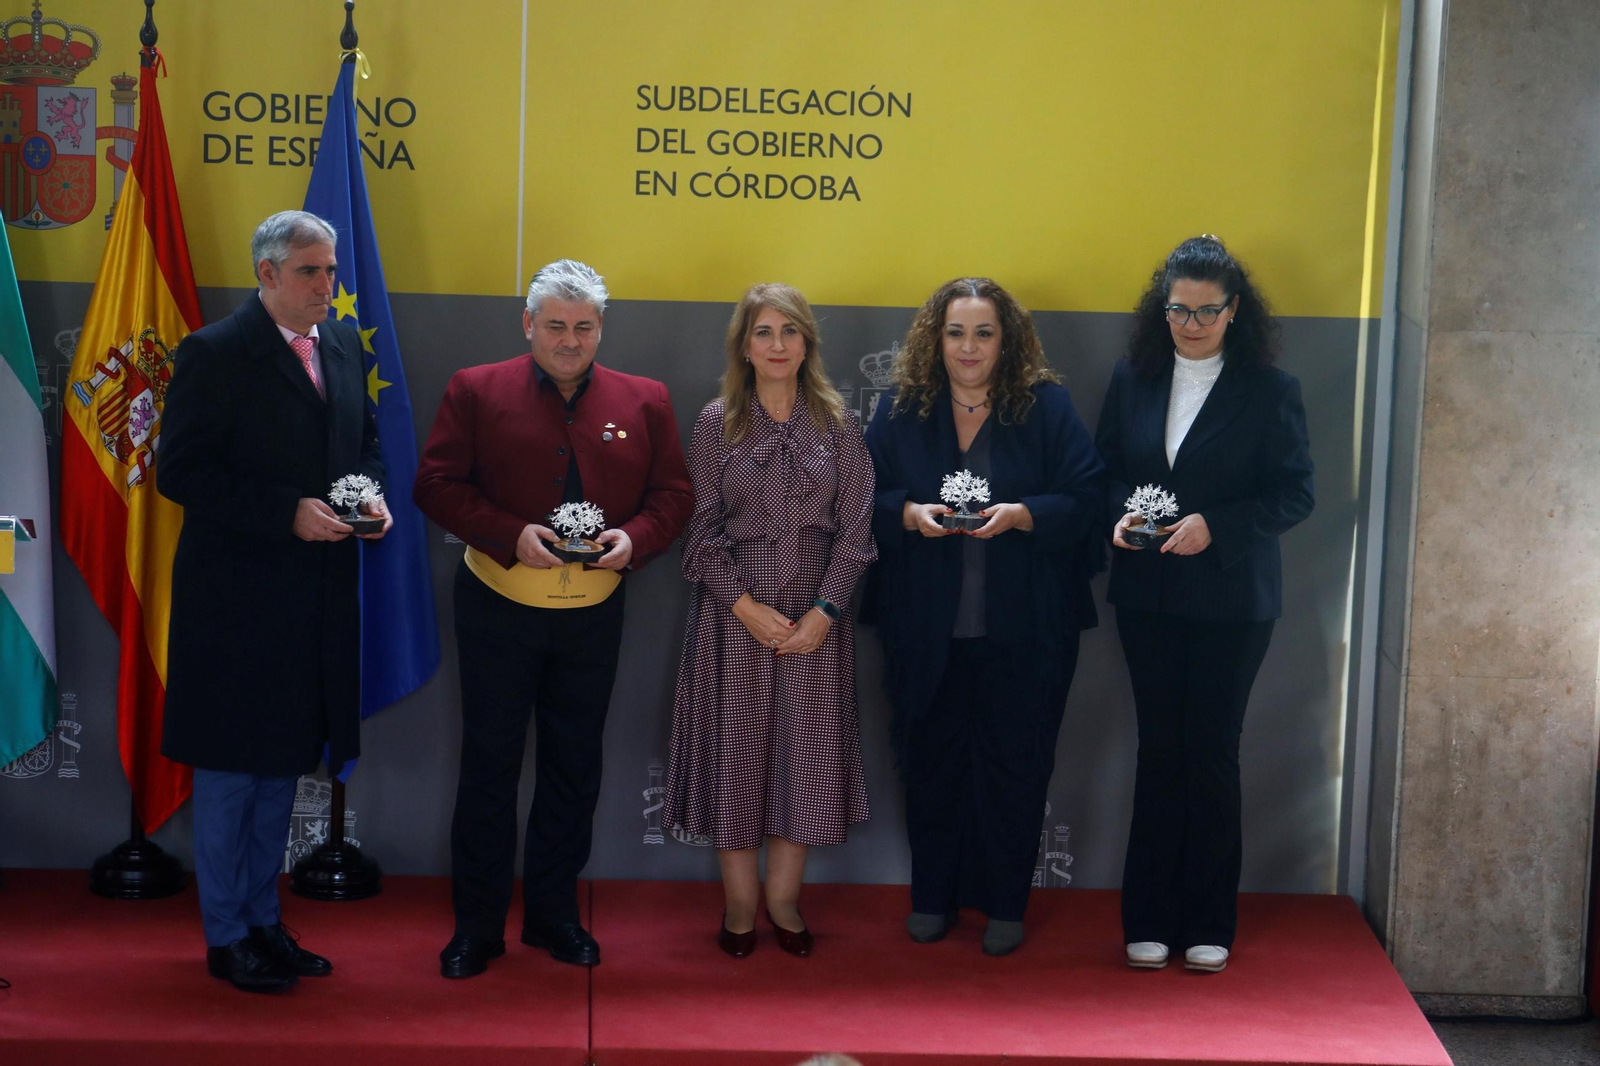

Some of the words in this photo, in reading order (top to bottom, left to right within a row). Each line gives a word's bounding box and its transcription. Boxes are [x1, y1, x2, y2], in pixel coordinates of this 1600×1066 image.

[202, 90, 417, 128] GOBIENO
[636, 84, 912, 118] SUBDELEGACIÓN
[203, 133, 254, 165] DE
[636, 127, 696, 154] DEL
[706, 129, 883, 160] GOBIERNO
[635, 170, 677, 197] EN
[689, 166, 862, 202] CÓRDOBA
